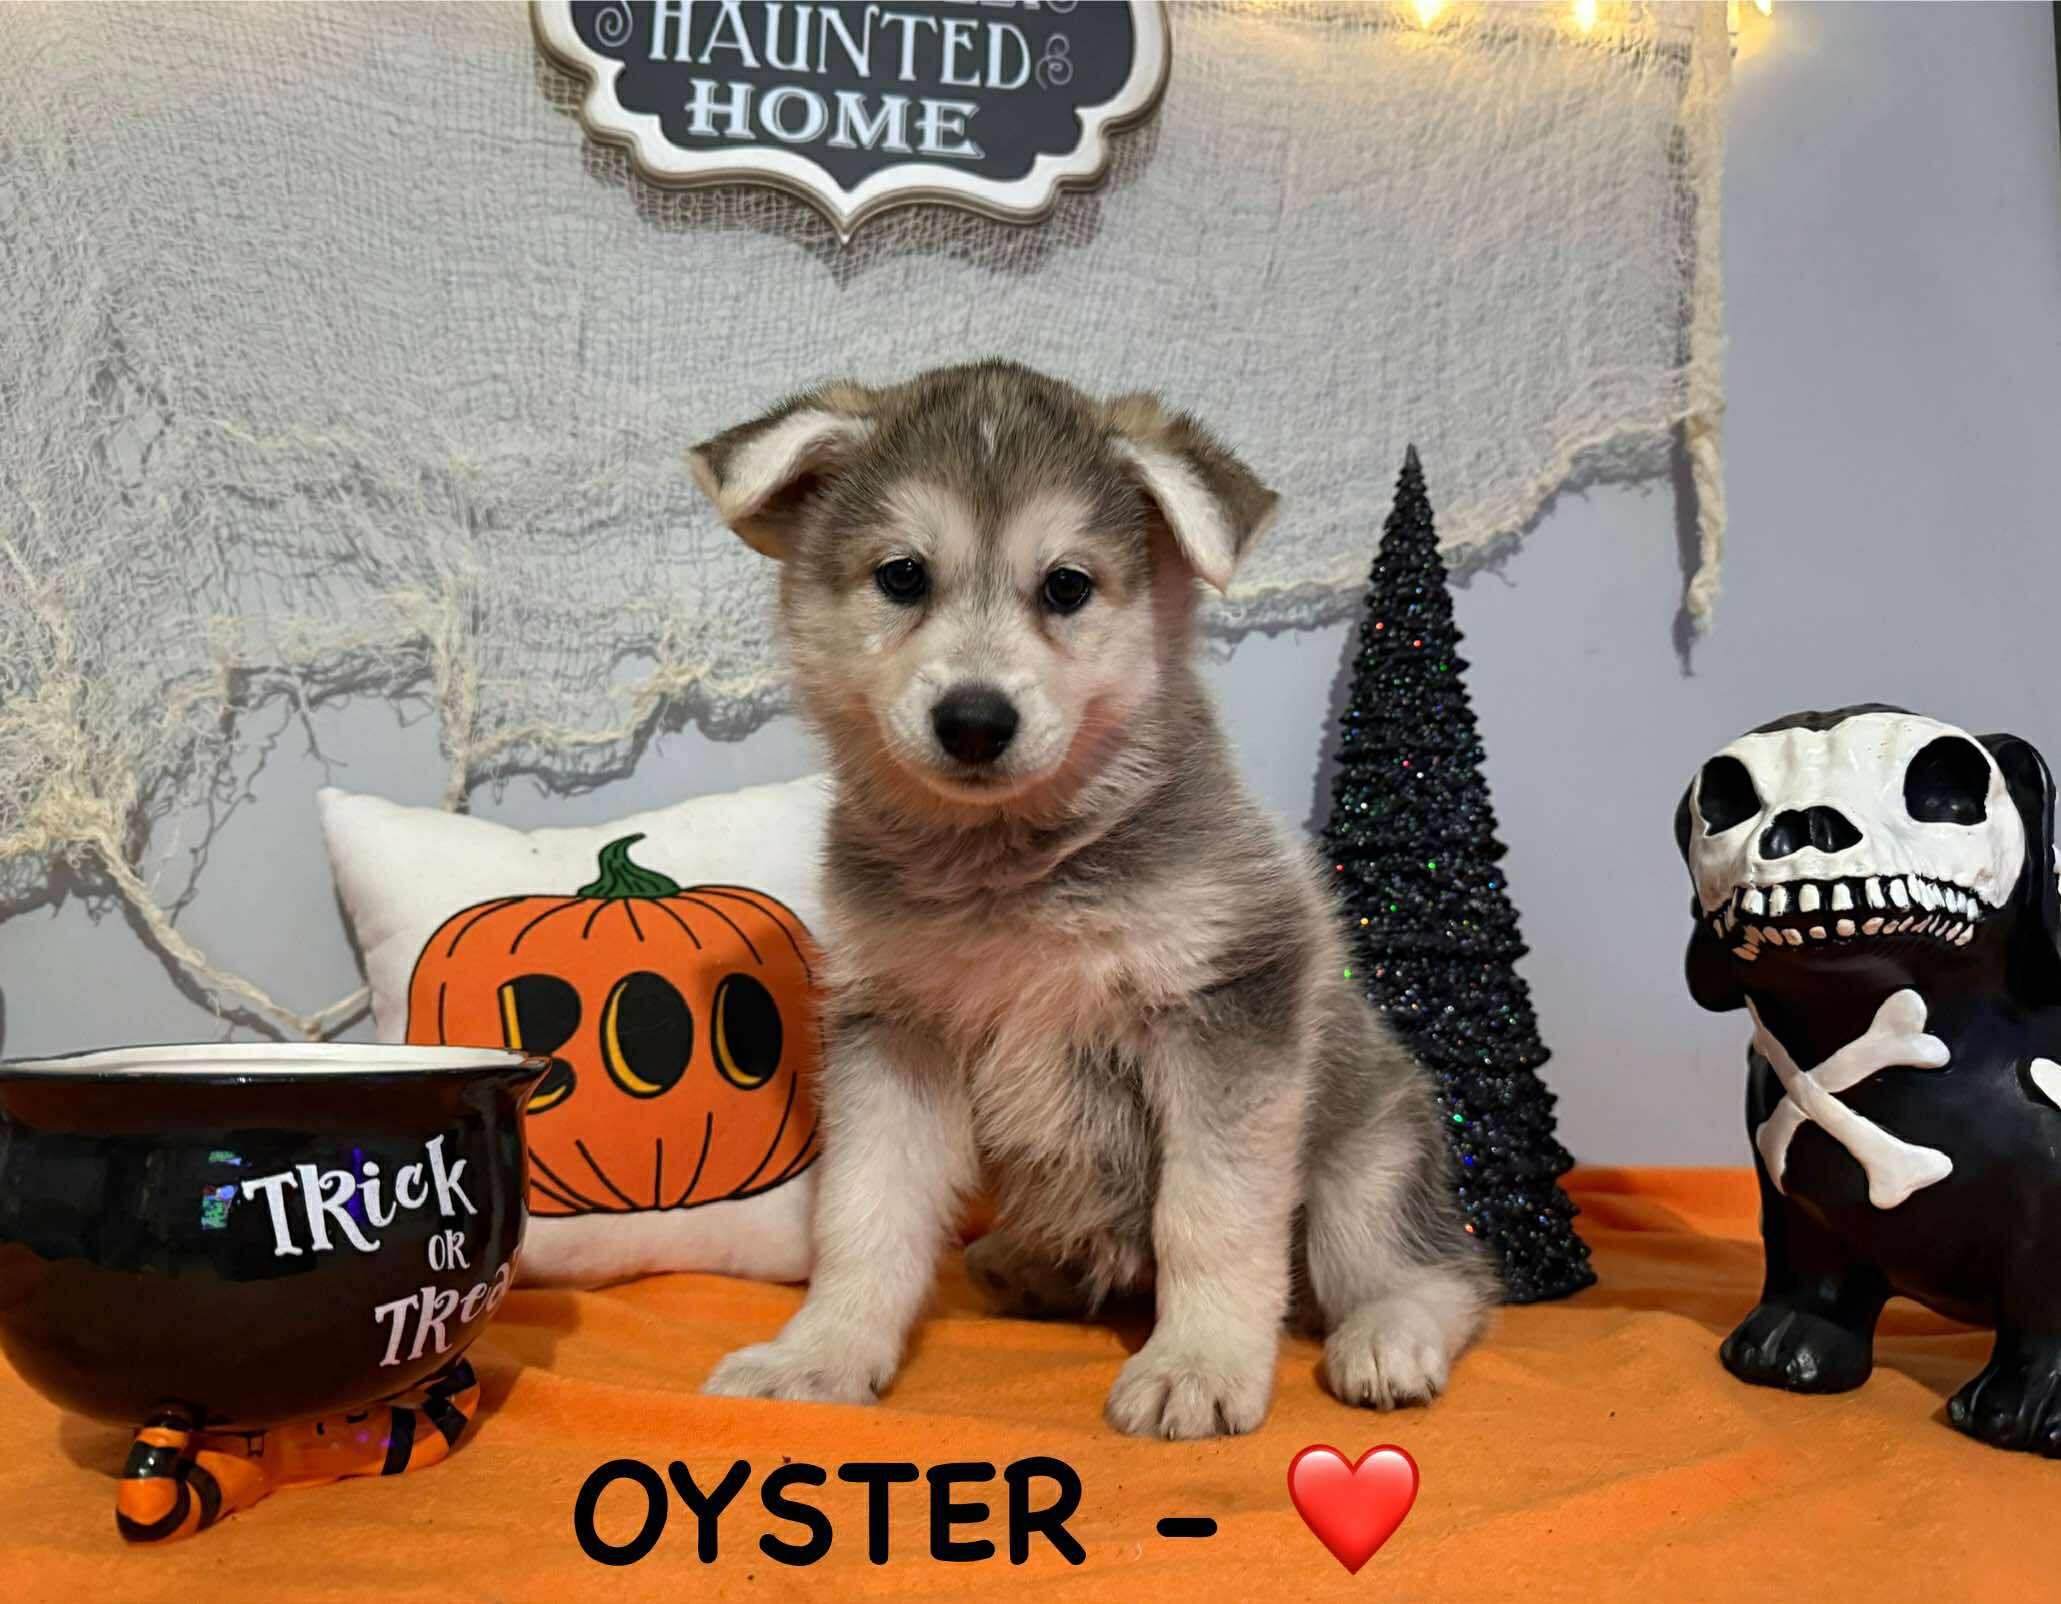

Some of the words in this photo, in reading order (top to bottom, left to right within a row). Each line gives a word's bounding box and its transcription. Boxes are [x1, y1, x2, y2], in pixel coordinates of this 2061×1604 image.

[648, 0, 1031, 90] HAUNTED
[684, 78, 986, 160] HOME
[427, 1229, 471, 1272] OR
